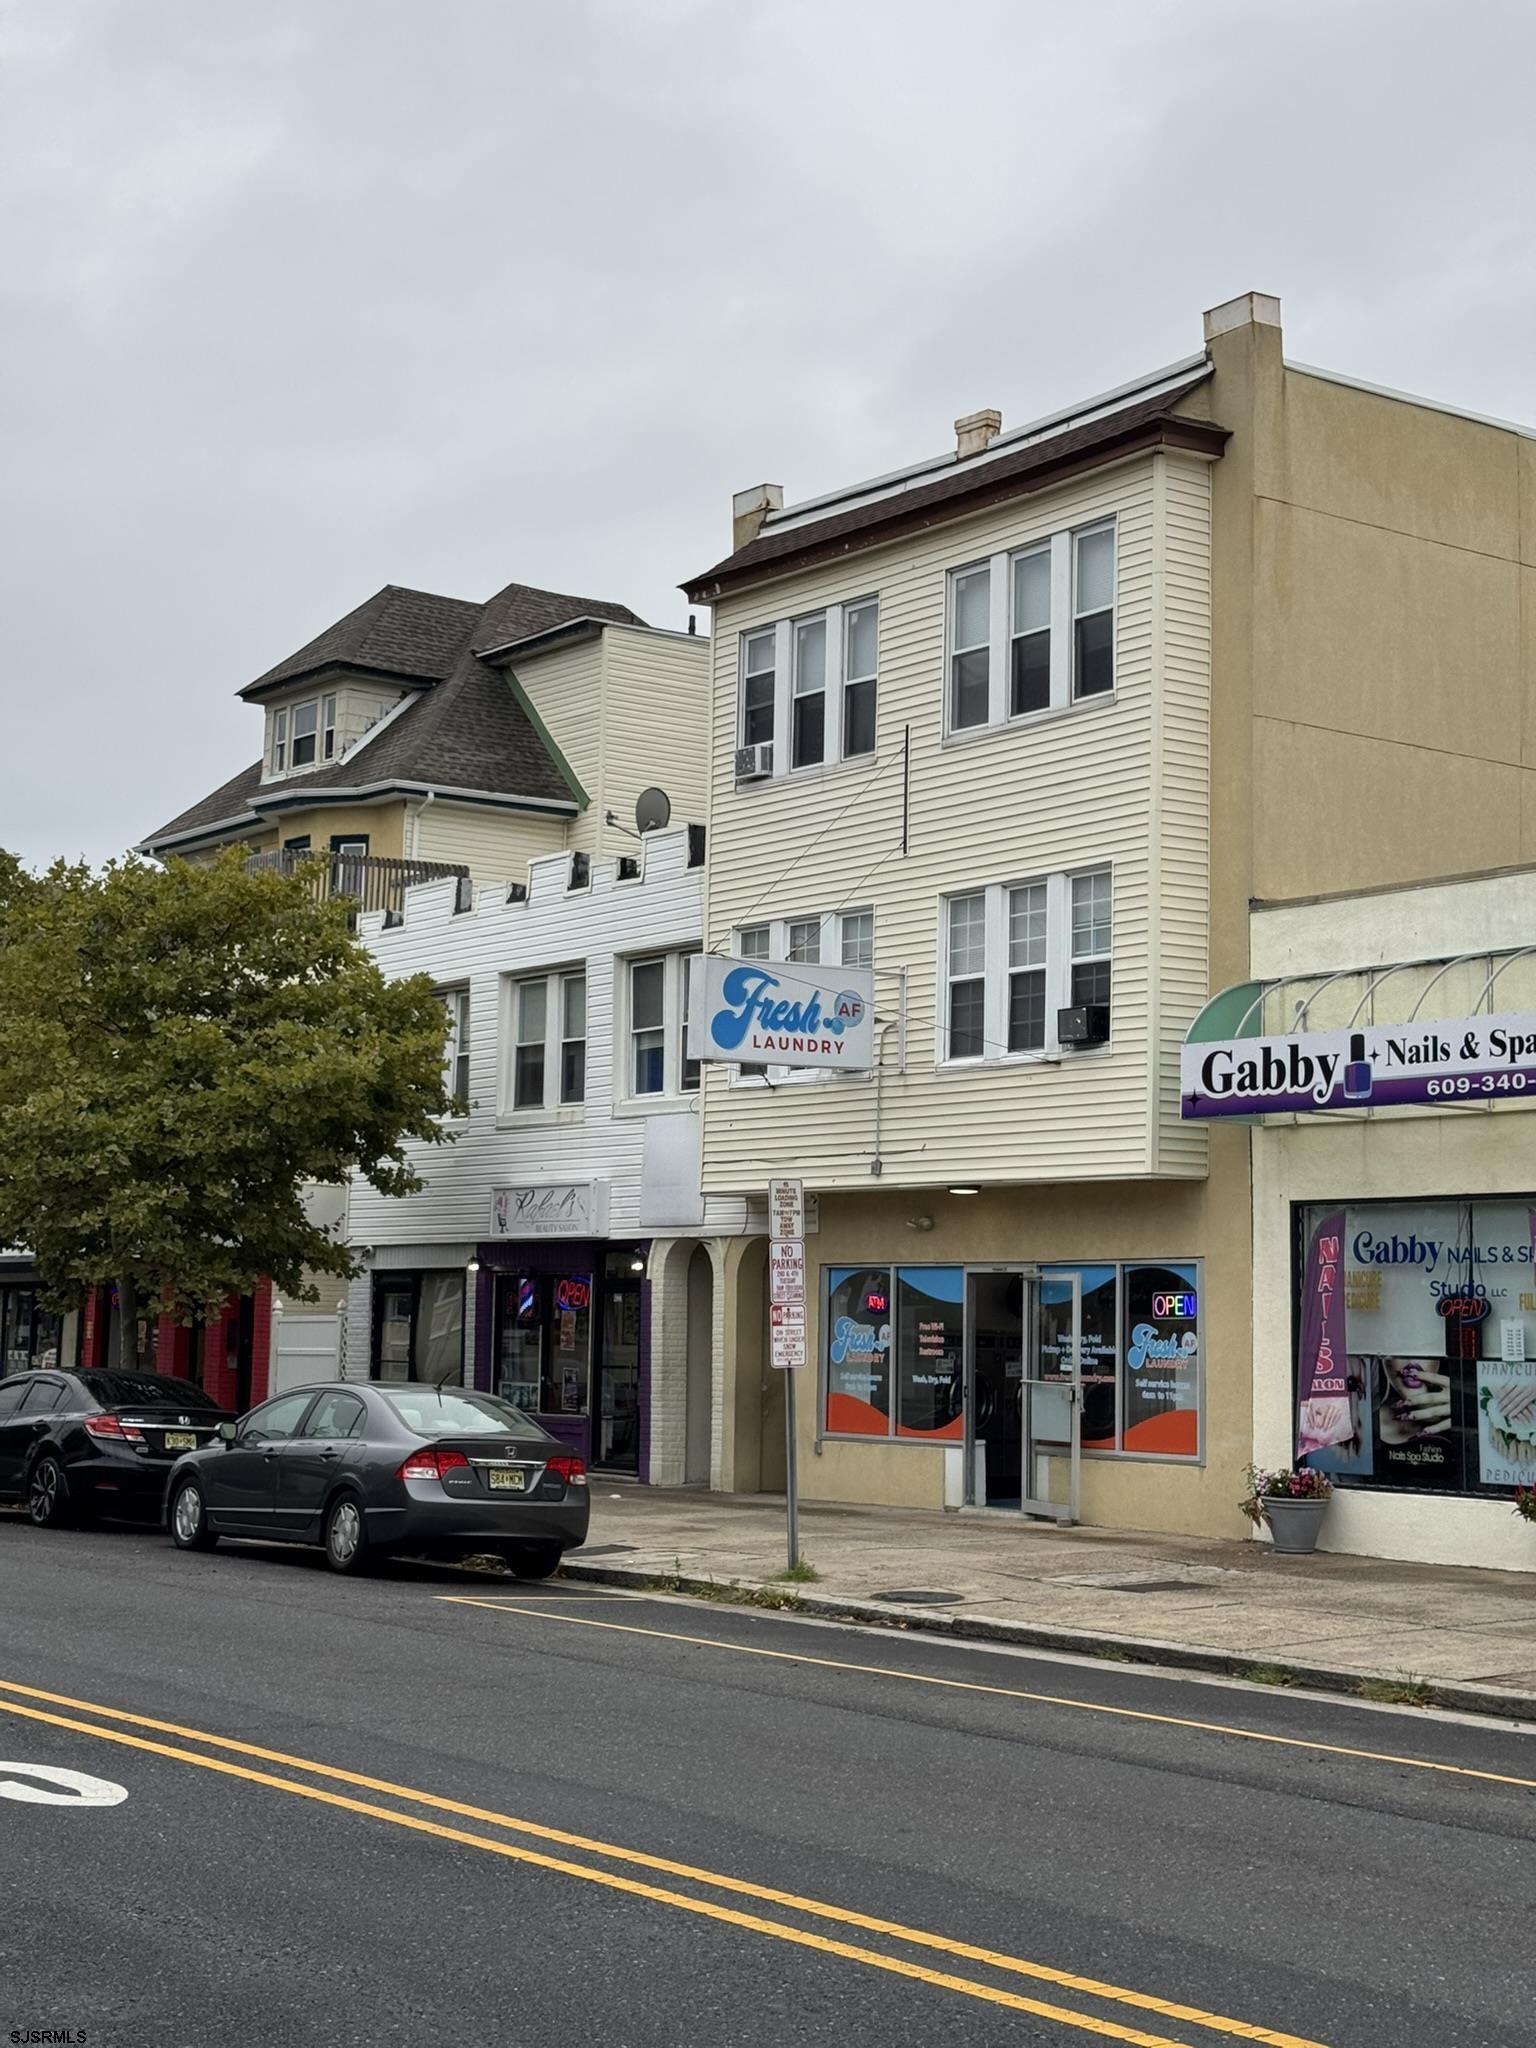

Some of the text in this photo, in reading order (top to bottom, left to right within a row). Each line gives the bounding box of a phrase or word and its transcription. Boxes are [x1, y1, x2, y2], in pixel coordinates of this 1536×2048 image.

[711, 966, 861, 1050] Fresh AF
[753, 1034, 844, 1055] LAUNDRY
[1201, 1028, 1536, 1099] Gabby Nails & Spa
[1427, 1073, 1536, 1096] 609-340-
[781, 1245, 794, 1258] NO
[1353, 1230, 1444, 1273] Gabby
[1448, 1246, 1498, 1264] NAILS
[1501, 1245, 1514, 1263] &
[772, 1258, 803, 1270] PARKING
[559, 1280, 589, 1307] OPEN
[1429, 1279, 1508, 1298] Studio LLC
[868, 1295, 885, 1310] ATM
[1154, 1295, 1195, 1316] OPEN
[1440, 1298, 1483, 1317] OPEN
[773, 1309, 804, 1322] NO PARKING
[1481, 1362, 1536, 1377] MANICU
